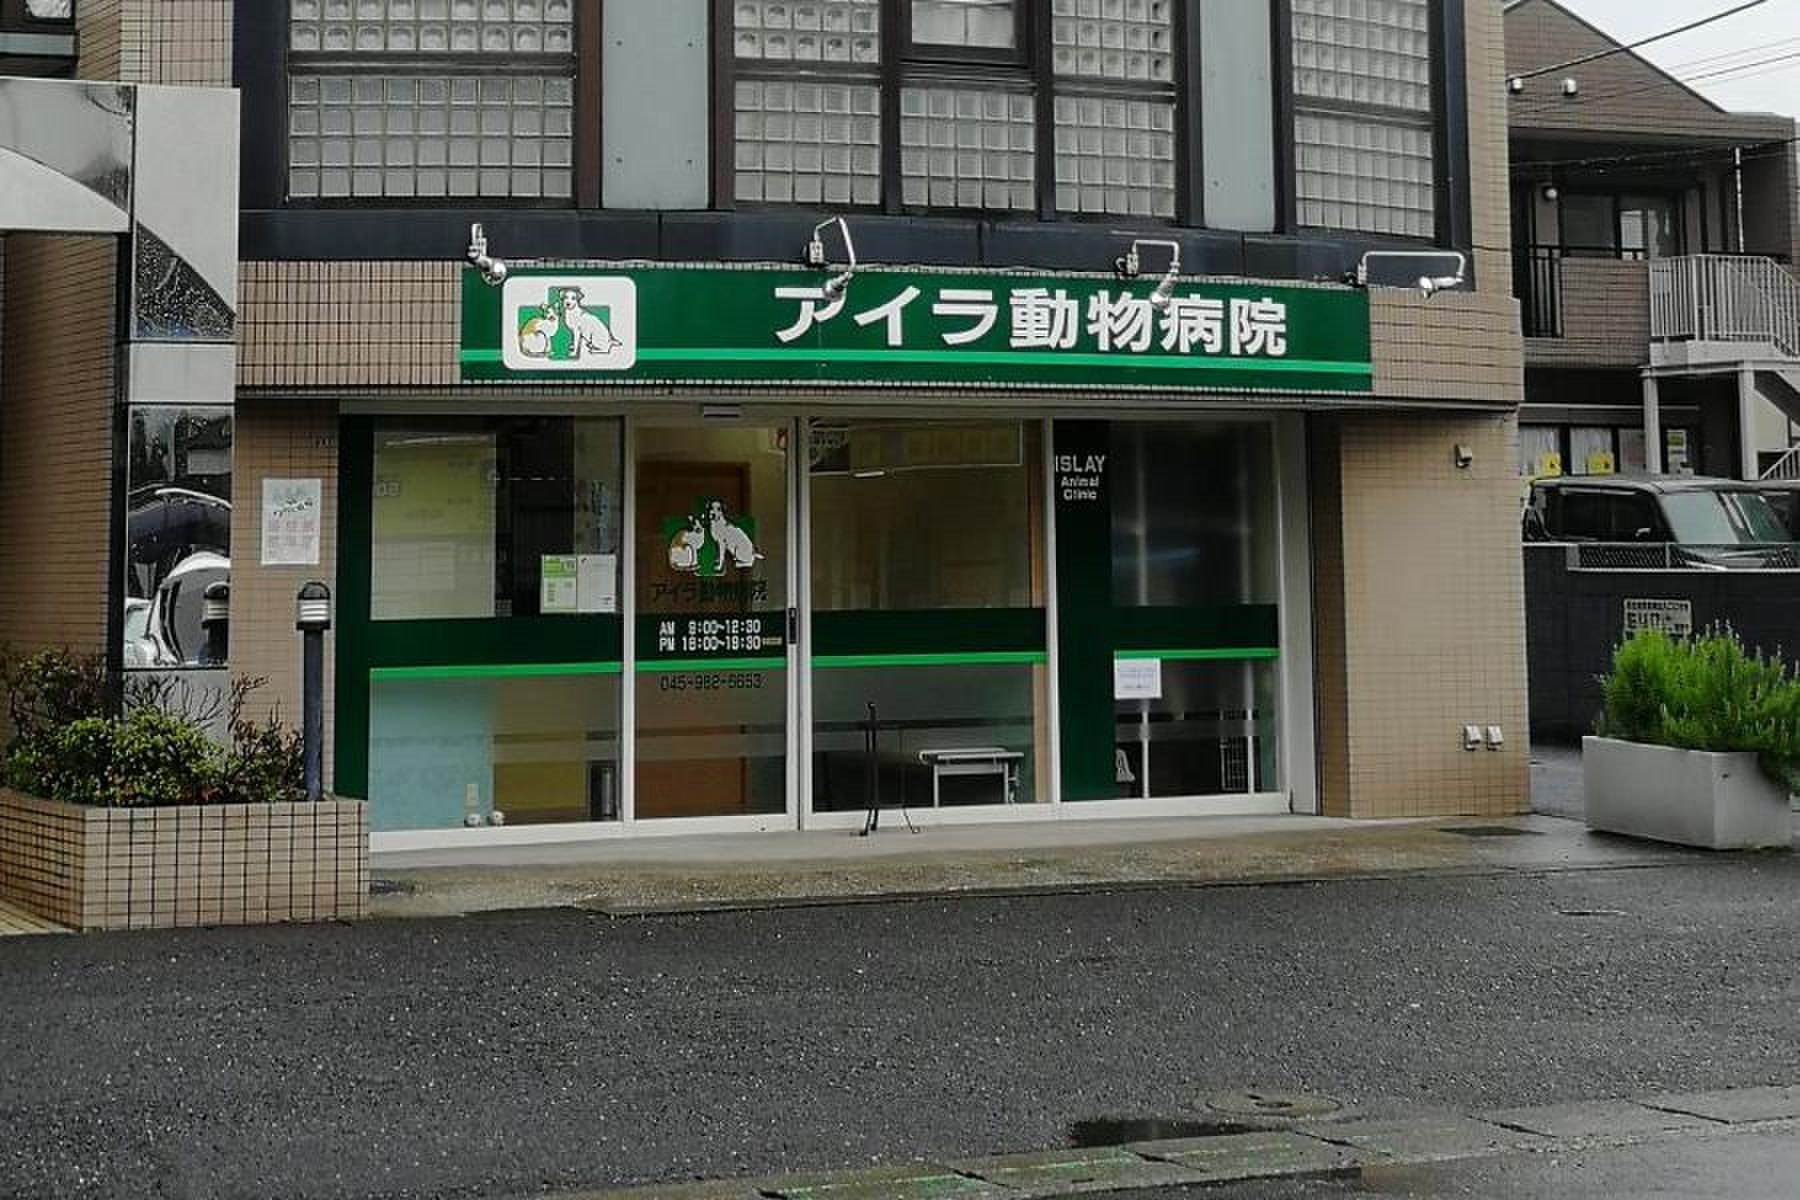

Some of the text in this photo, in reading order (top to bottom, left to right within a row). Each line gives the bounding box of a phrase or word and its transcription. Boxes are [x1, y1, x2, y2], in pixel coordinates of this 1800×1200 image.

[774, 285, 1287, 355] アイラ動物病院
[1055, 454, 1105, 473] ISLAY
[659, 620, 675, 636] AM
[659, 636, 675, 652] PM
